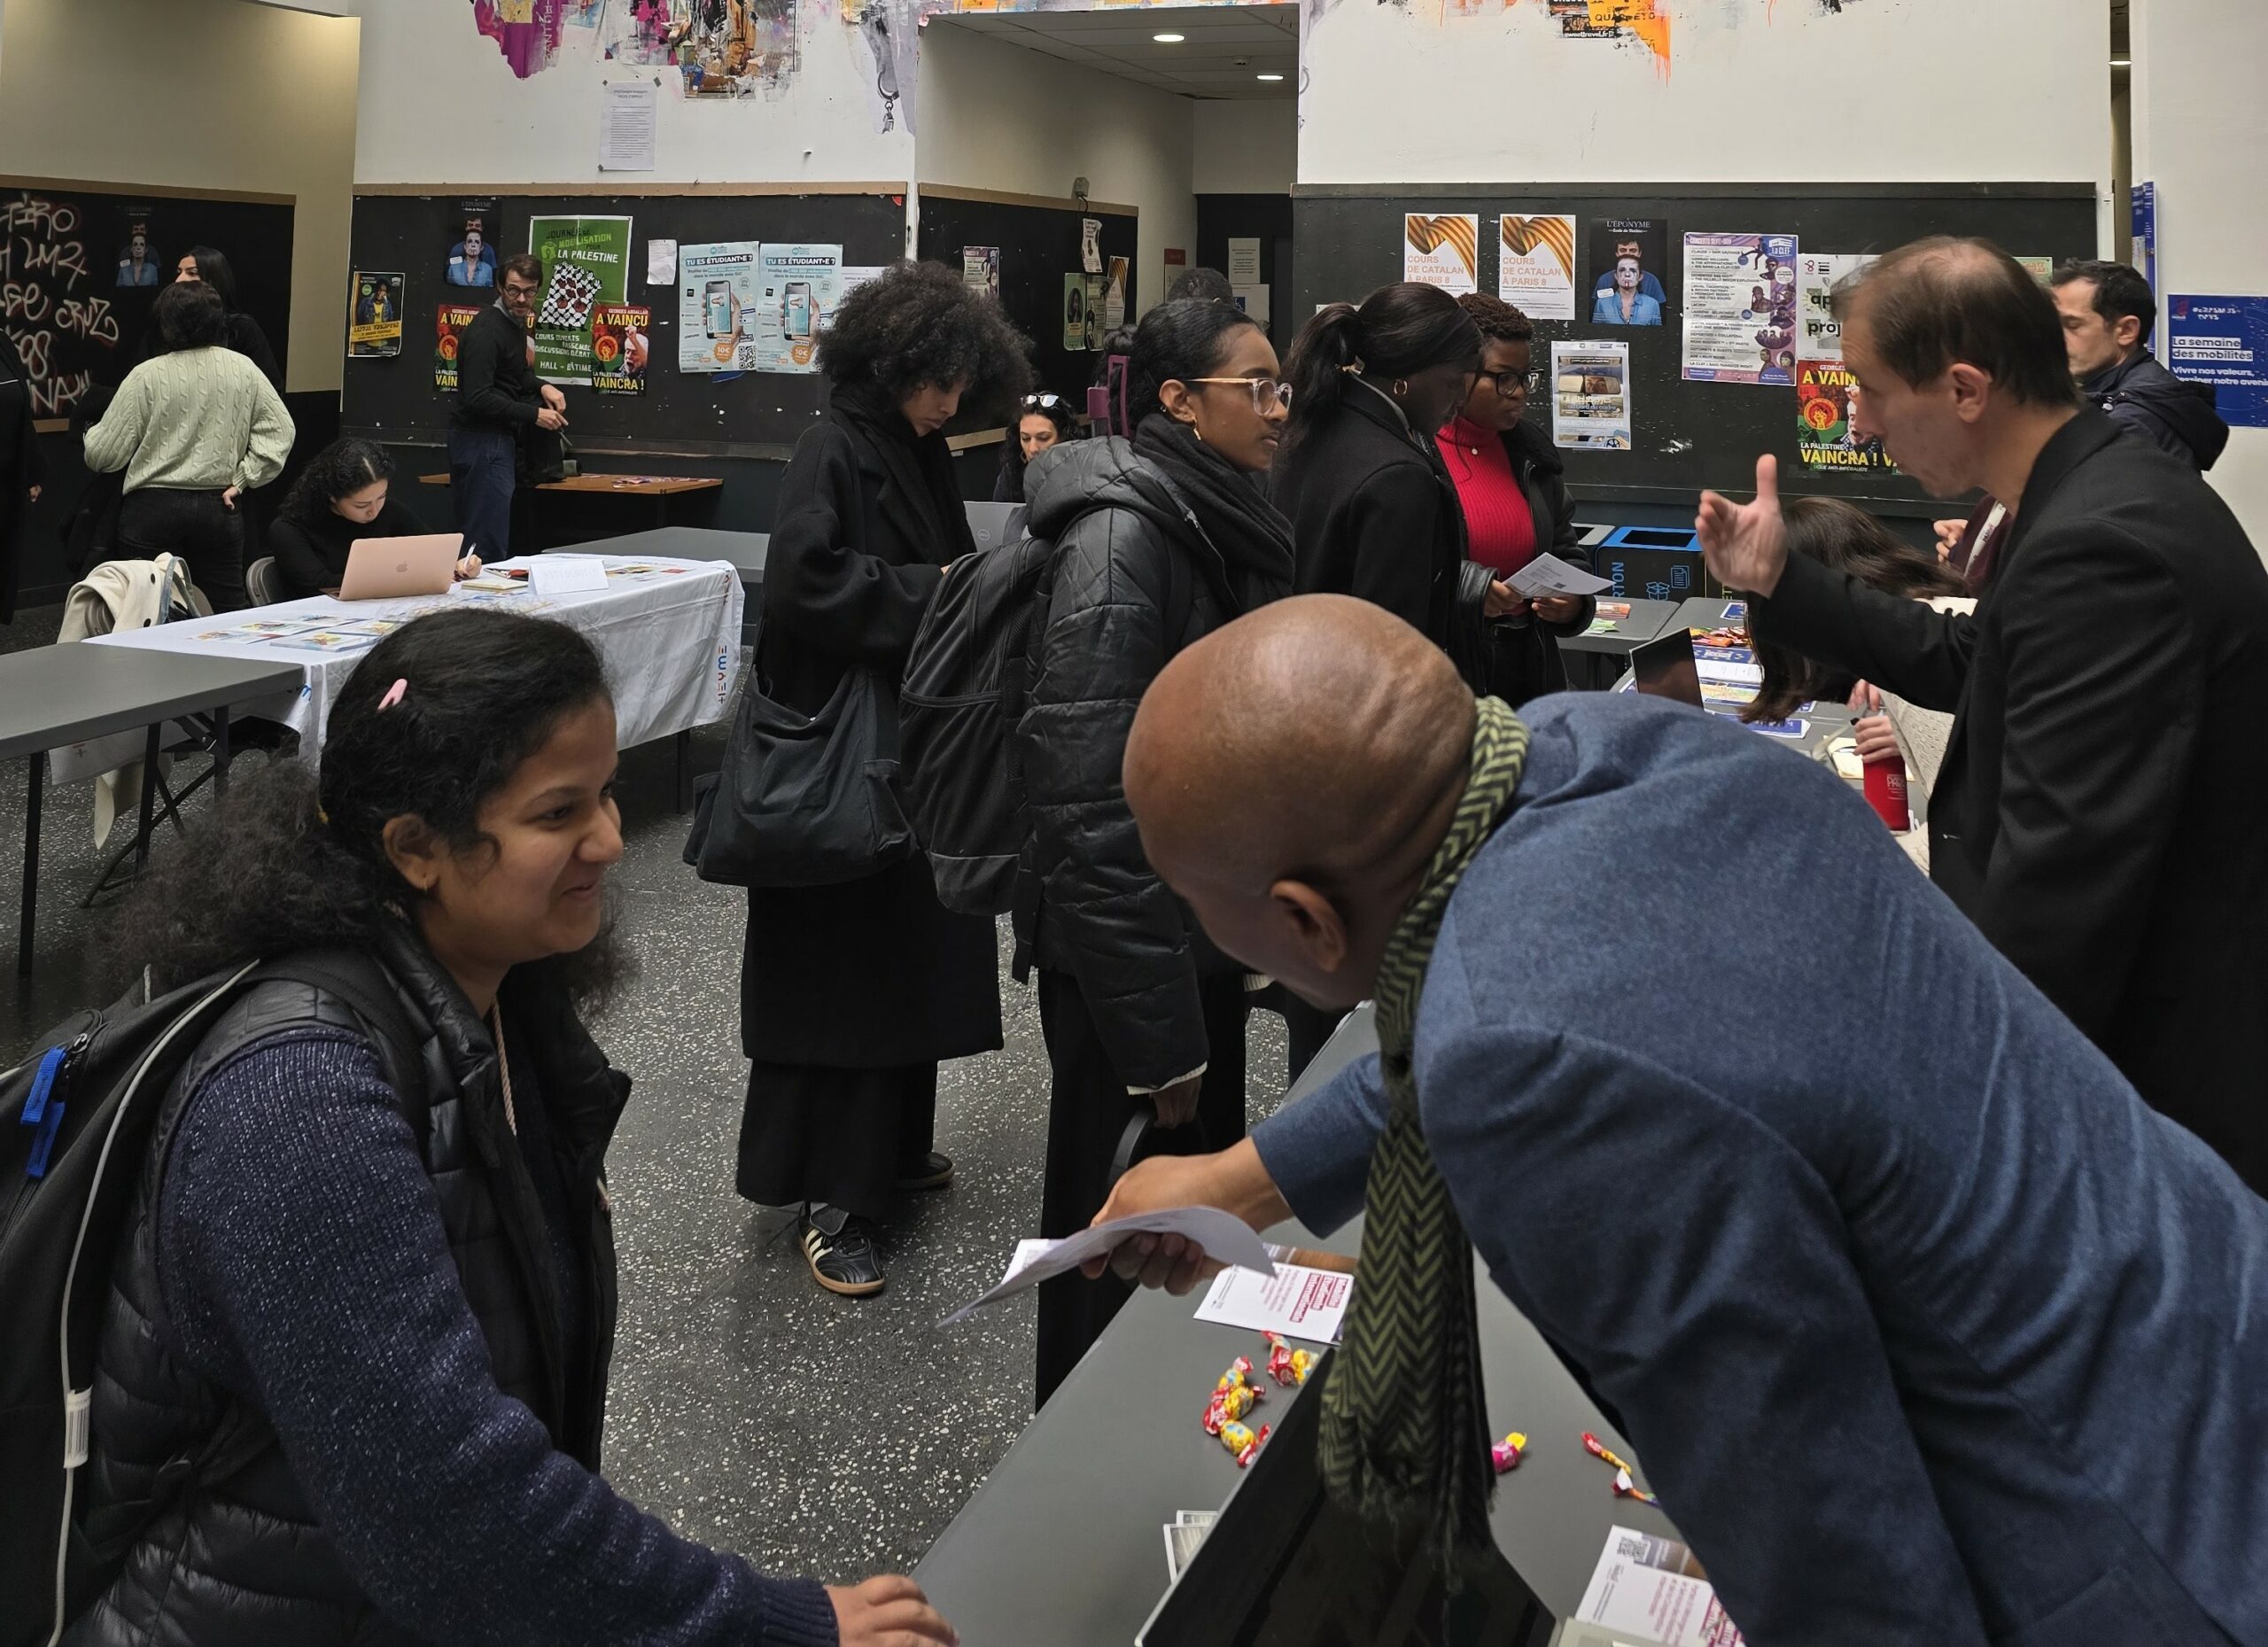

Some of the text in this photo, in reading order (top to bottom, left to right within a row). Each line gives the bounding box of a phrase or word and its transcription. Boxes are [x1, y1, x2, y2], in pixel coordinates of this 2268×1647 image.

[559, 233, 611, 248] MOBILISATION
[558, 250, 618, 263] LA PALESTINE
[1517, 268, 1561, 276] CATALAN
[440, 313, 474, 327] A VAIN
[596, 314, 648, 326] A VAINCU
[2189, 338, 2241, 347] semaine
[2197, 350, 2252, 360] mobilités
[593, 377, 644, 390] VAINCRA !
[1803, 370, 1814, 384] A
[1801, 449, 1868, 466] VAINCRA
[1873, 452, 1877, 466] !
